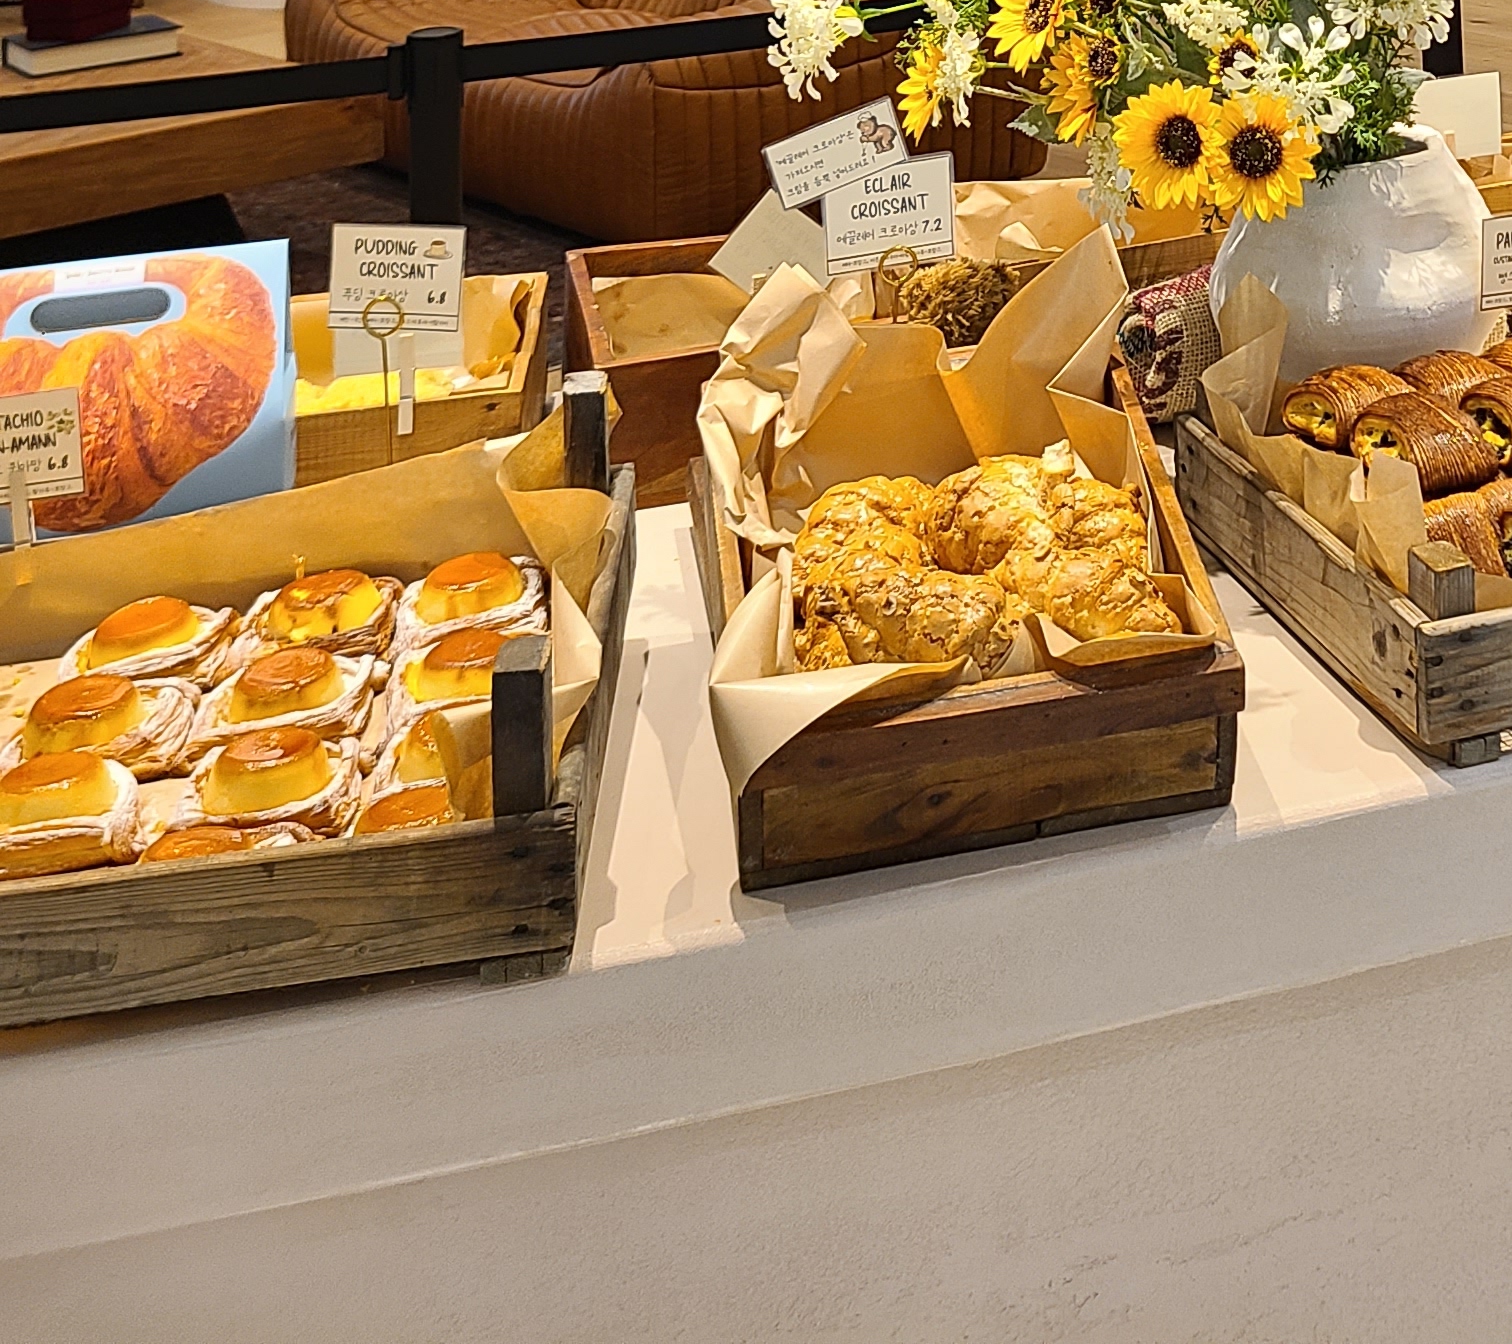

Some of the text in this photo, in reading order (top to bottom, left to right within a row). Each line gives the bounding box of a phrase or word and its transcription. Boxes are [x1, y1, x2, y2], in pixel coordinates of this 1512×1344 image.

[864, 172, 912, 194] ECLAIR
[850, 193, 929, 220] CROISSANT
[878, 220, 919, 239] 크로아상
[921, 217, 943, 234] 7.2
[354, 238, 419, 256] PUDDING
[359, 261, 439, 280] CROISSANT
[342, 287, 447, 305] 푸딩 크로아상 6.8
[48, 454, 69, 470] 6.8
